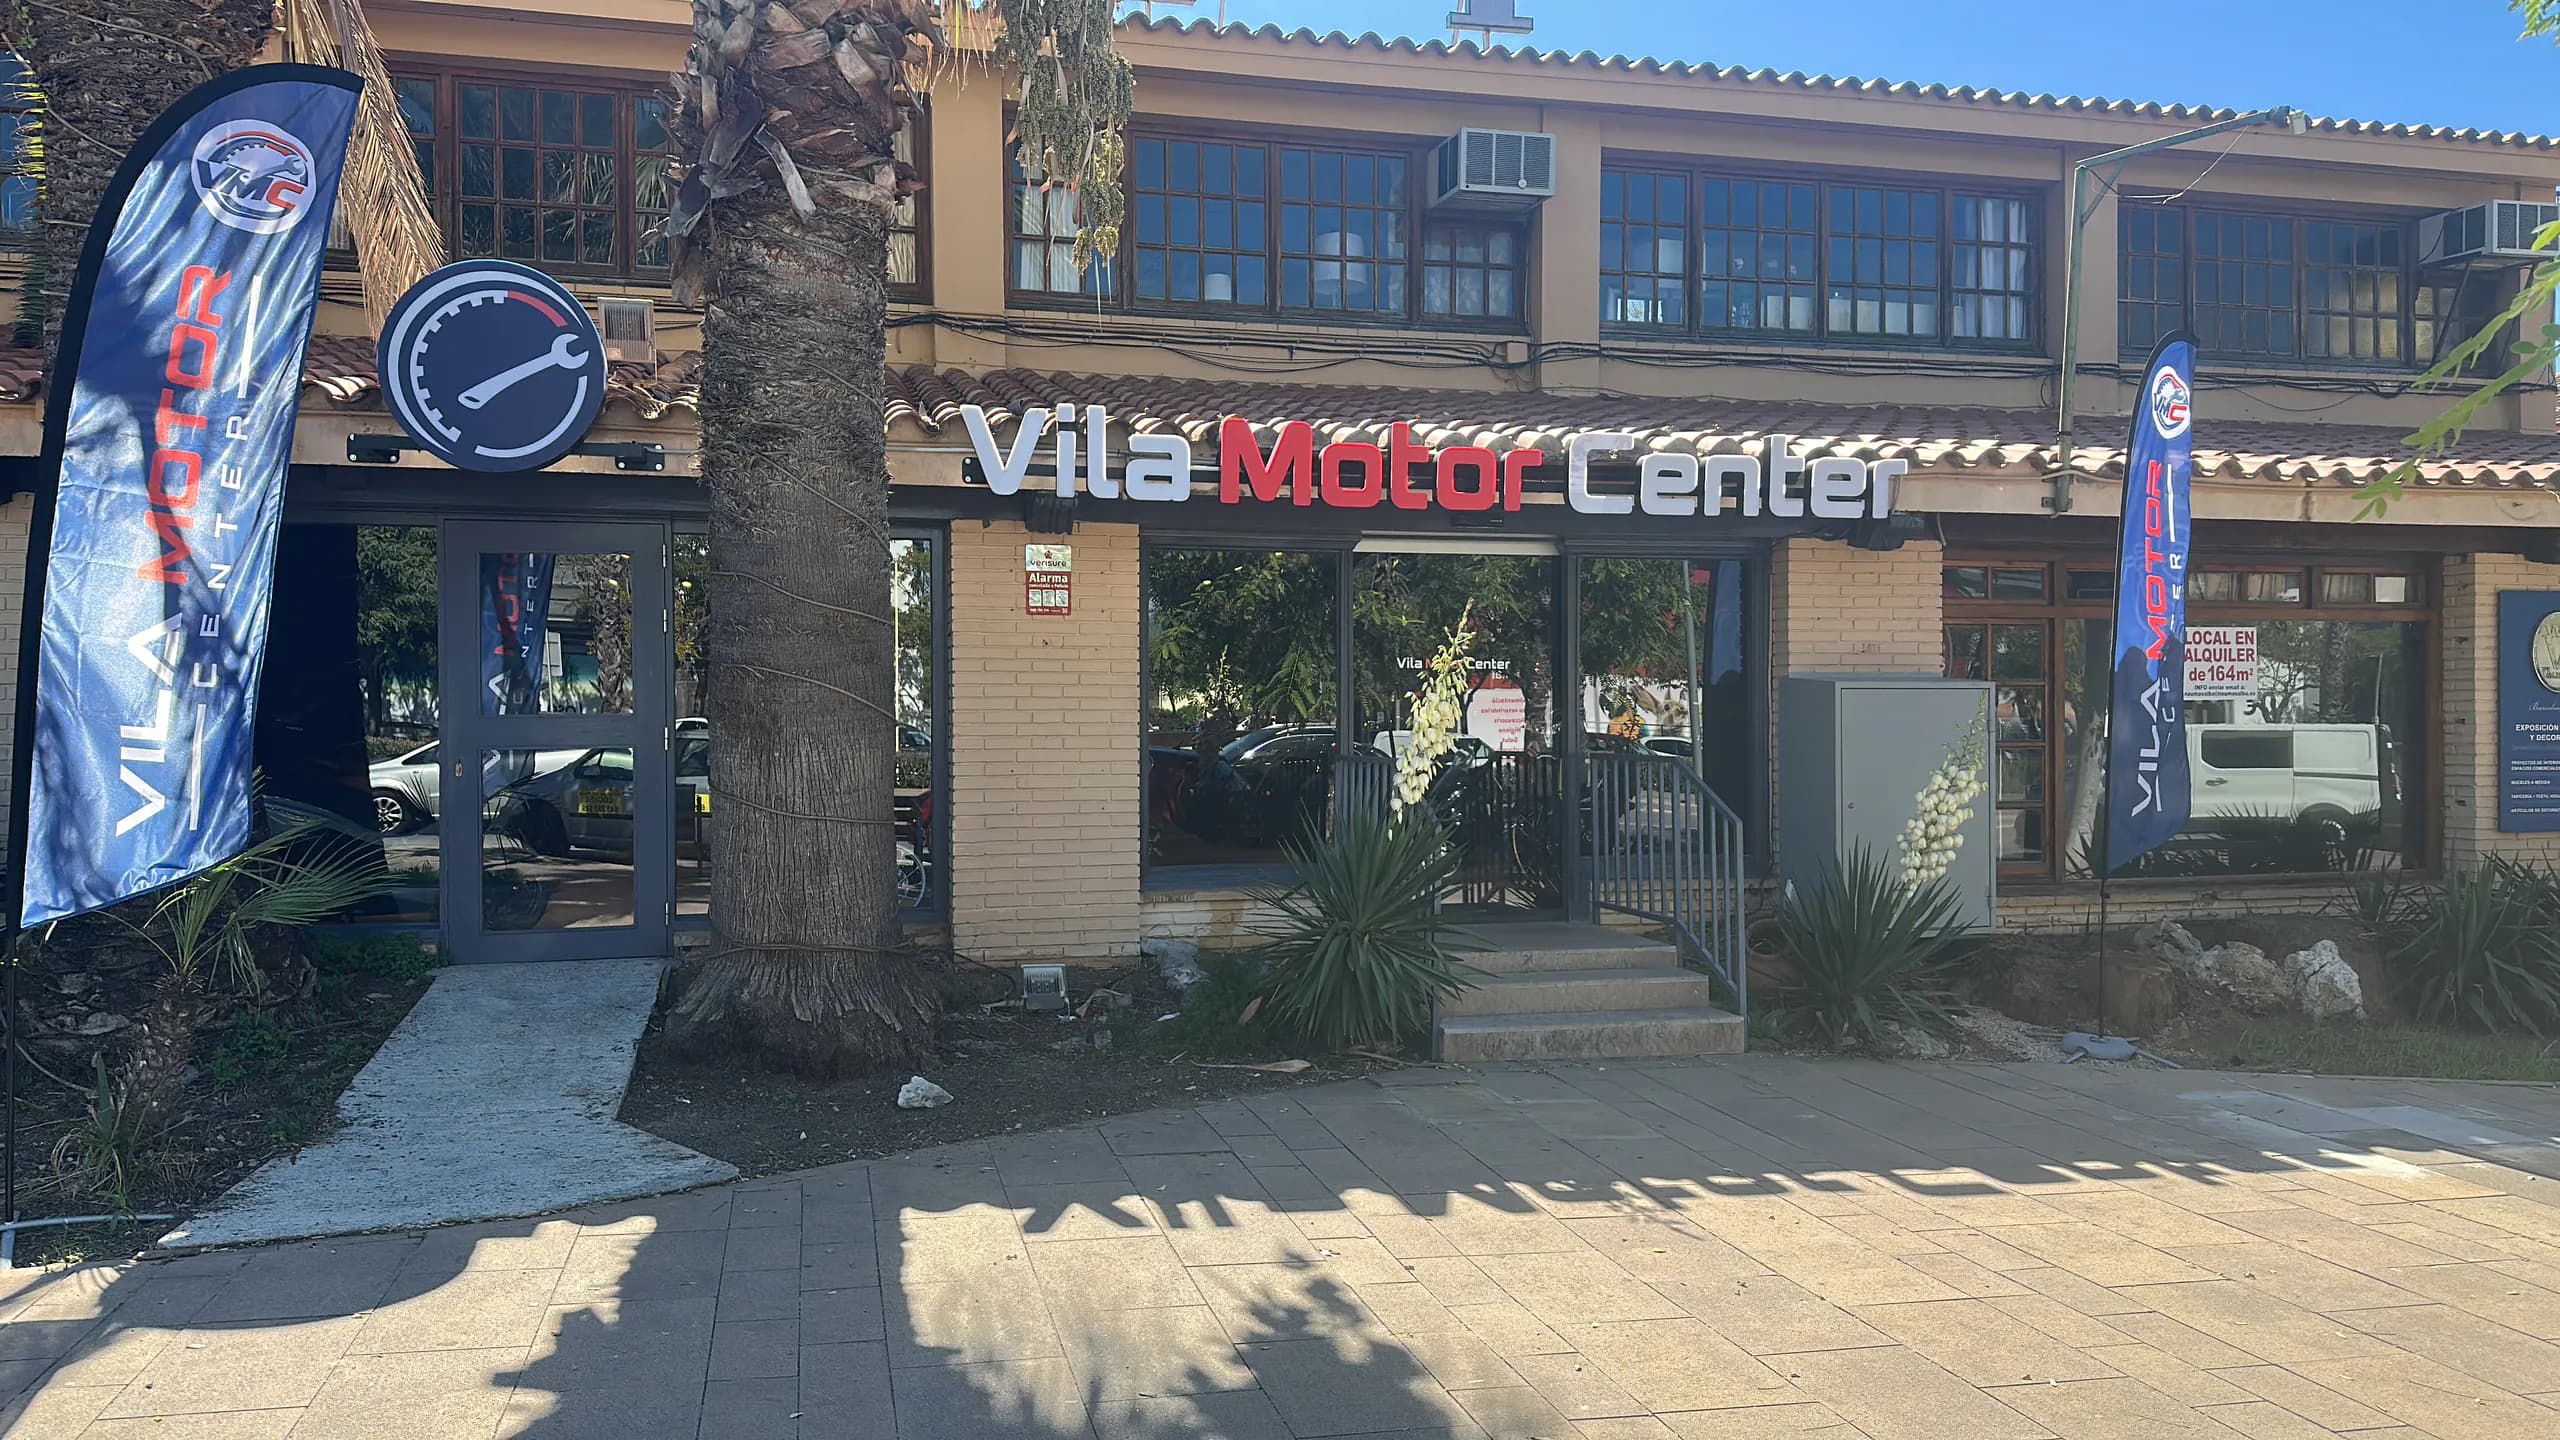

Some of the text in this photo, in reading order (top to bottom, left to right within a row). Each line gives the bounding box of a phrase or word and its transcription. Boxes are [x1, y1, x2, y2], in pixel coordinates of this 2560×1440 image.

[197, 159, 304, 211] VMC
[2154, 393, 2187, 421] VMC
[960, 403, 1908, 520] Vila Motor Center
[115, 265, 232, 838] VILA MOTOR
[193, 415, 250, 688] CENTER
[1029, 572, 1068, 583] Alarma
[2131, 459, 2167, 816] VILA MOTOR
[2185, 631, 2254, 645] LOCAL EN
[1396, 657, 1423, 669] Vila
[1466, 658, 1511, 670] Center
[2184, 648, 2255, 663] ALQUILER
[2189, 667, 2206, 681] de
